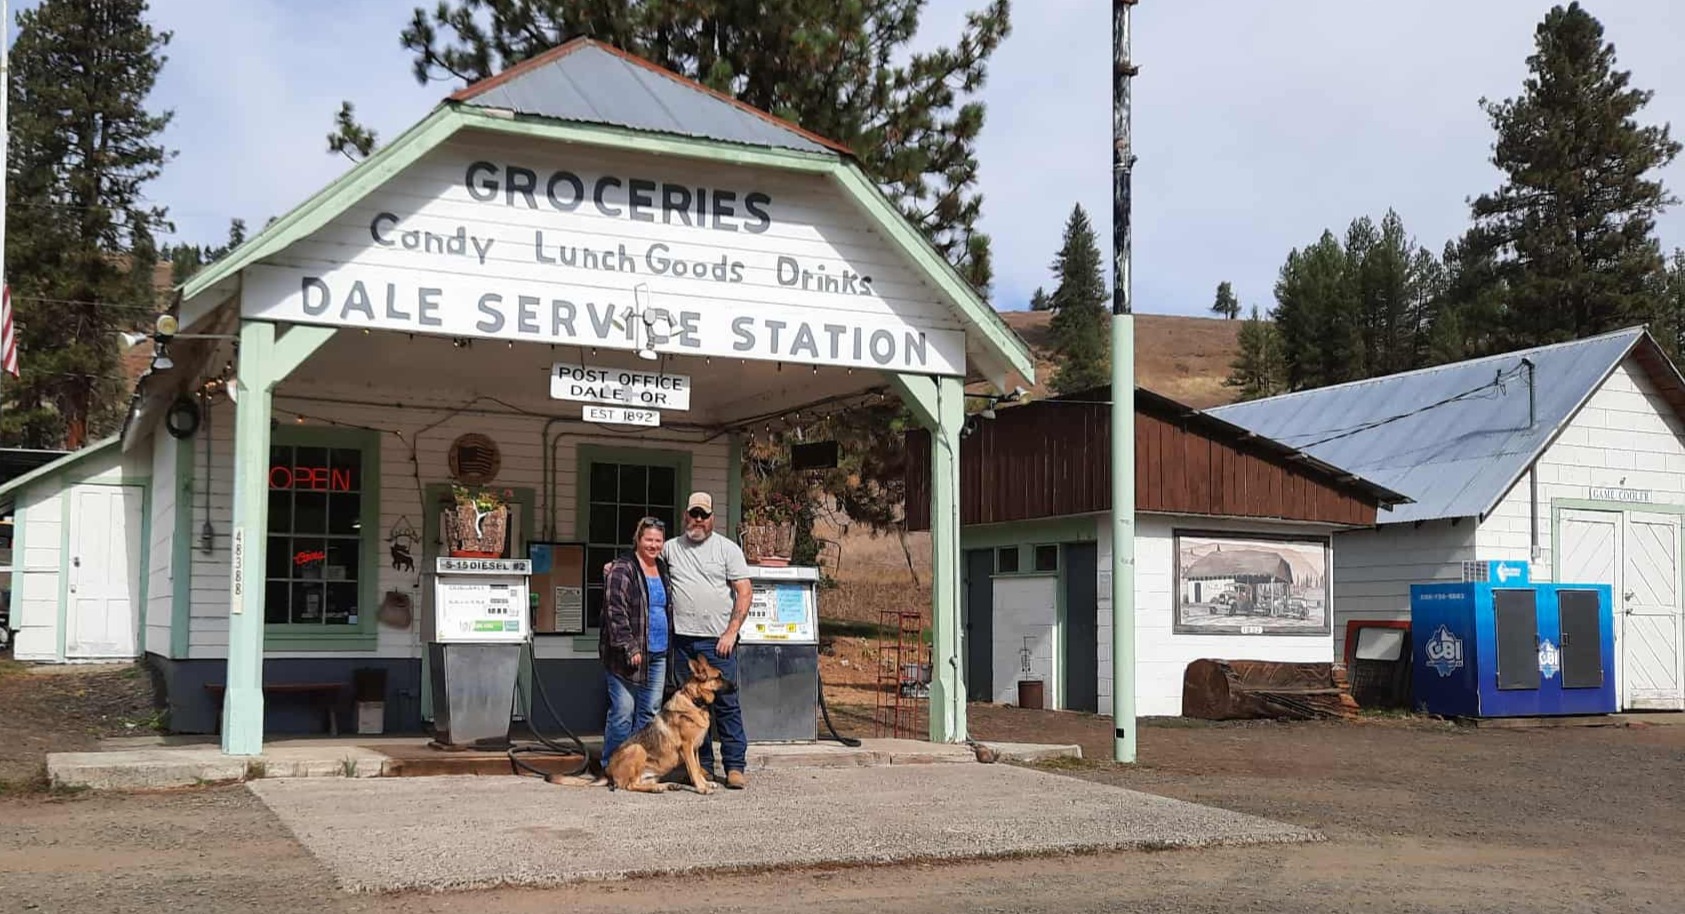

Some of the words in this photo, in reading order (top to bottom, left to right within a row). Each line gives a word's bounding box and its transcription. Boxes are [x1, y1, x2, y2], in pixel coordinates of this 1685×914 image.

[465, 161, 772, 234] GROCERIES
[370, 212, 495, 265] Candy
[535, 230, 636, 273] Lunch
[645, 243, 745, 283] Goods
[776, 256, 872, 296] Drinks
[301, 277, 443, 327] DALE
[731, 316, 927, 365] STATION
[558, 367, 609, 384] POST
[619, 373, 684, 391] OFFICE
[590, 408, 616, 420] EST
[623, 411, 654, 423] 1892
[269, 466, 351, 492] OPEN
[1592, 488, 1615, 500] GAME
[469, 562, 510, 571] DIESEL
